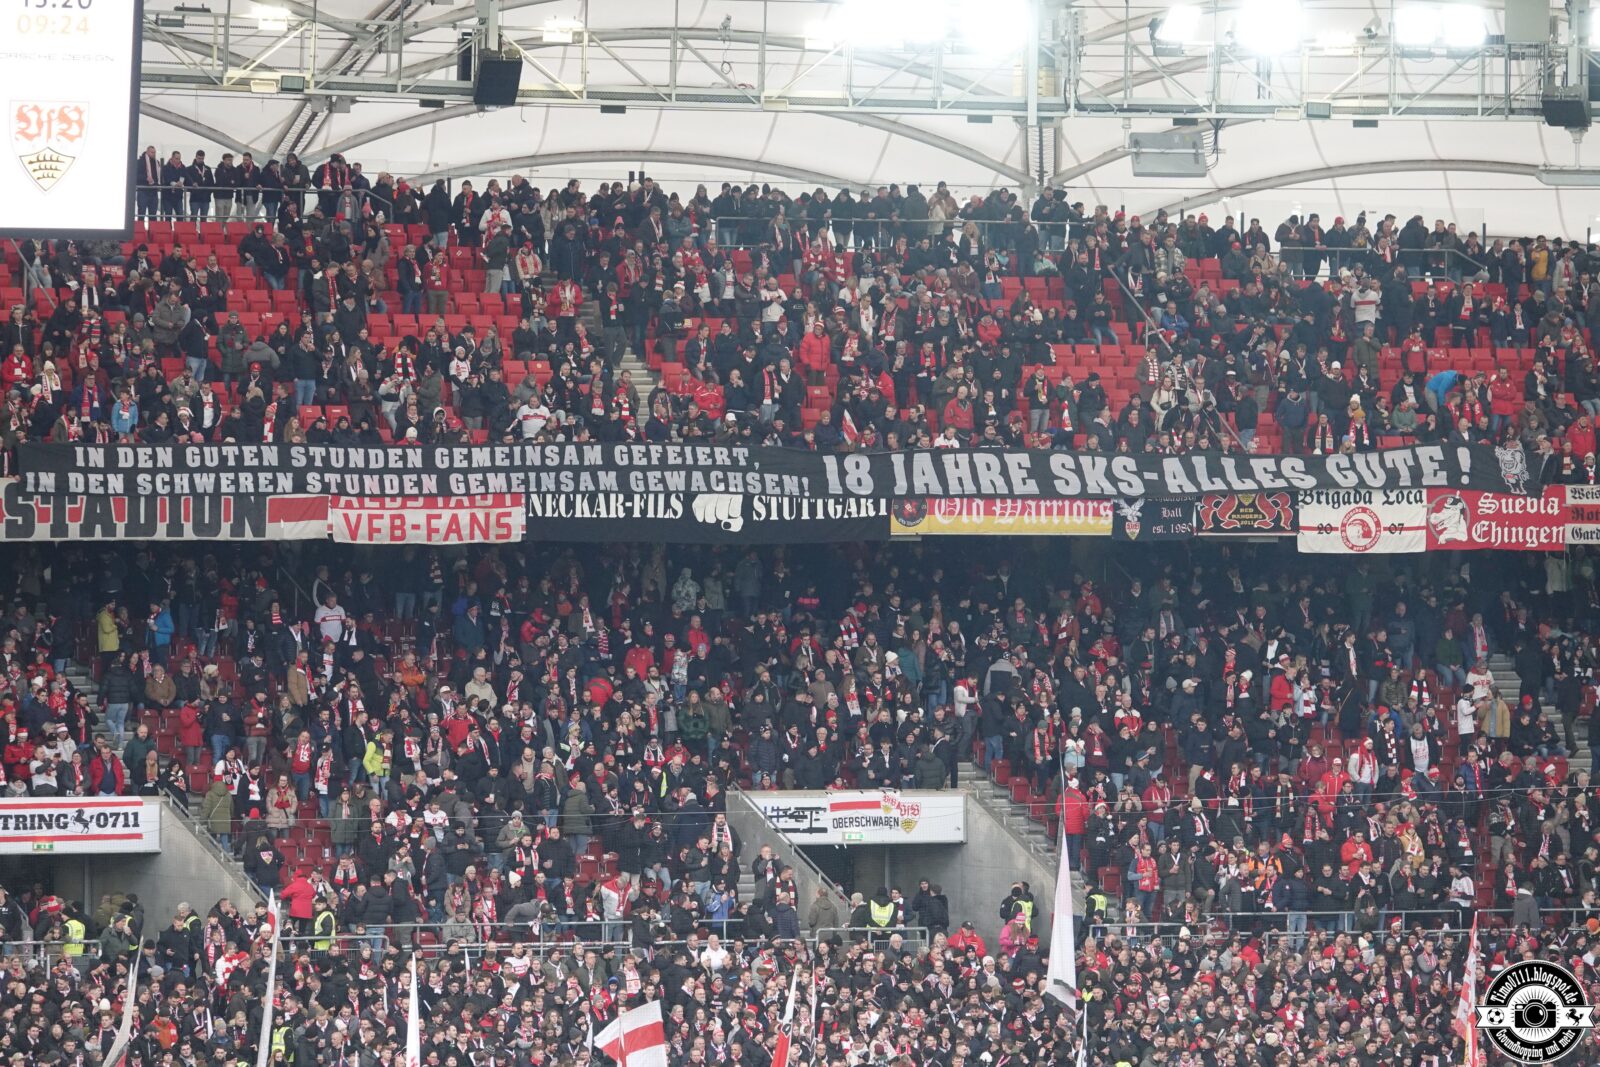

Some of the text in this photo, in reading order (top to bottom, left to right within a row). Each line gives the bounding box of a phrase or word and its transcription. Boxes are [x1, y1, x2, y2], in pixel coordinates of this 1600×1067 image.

[17, 14, 90, 34] 09:24
[15, 104, 85, 143] VfB
[75, 444, 760, 470] IN DEN GUTEN STUNDEN GEMEINSAM GEFEIERT,
[25, 471, 810, 497] IN DEN SCHWEREN STUNDEN GEMEINSAM GEWACHSEN!
[822, 453, 875, 496] 18
[890, 452, 1040, 496] JAHRE
[528, 493, 683, 519] NECKAR-FILS
[752, 493, 887, 520] STUTTGART
[935, 498, 1113, 525] Old Warriors
[1298, 489, 1424, 509] Brigada Loca
[1478, 492, 1561, 515] Suevia
[1161, 507, 1182, 518] Hall
[343, 511, 512, 542] VFB-FANS
[1317, 523, 1405, 535] 20 07
[1472, 520, 1566, 548] Ehingen
[0, 811, 140, 831] TRING 0711
[832, 815, 900, 830] OBERSCHWABEN
